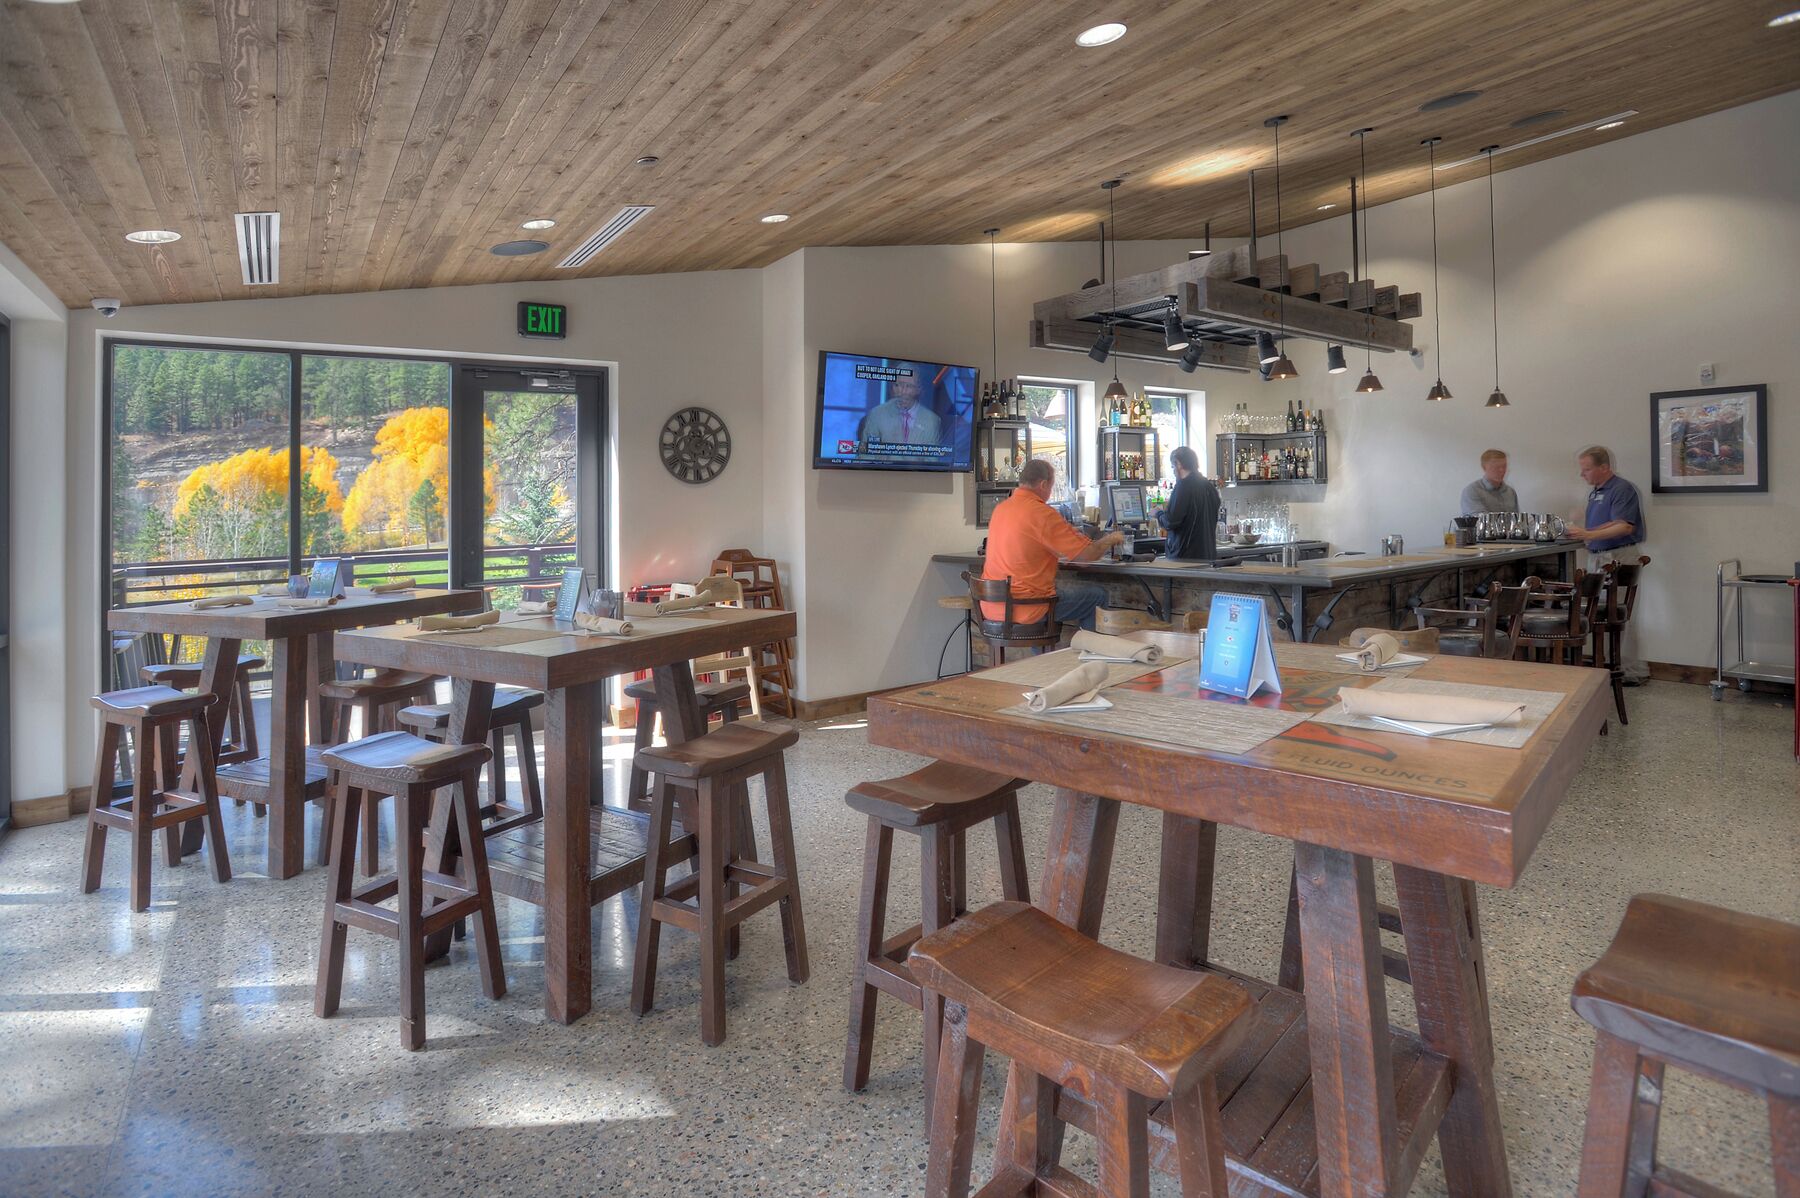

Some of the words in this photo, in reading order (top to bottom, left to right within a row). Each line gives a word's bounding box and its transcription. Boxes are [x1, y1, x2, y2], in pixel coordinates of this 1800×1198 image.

[527, 305, 561, 334] EXIT
[1288, 752, 1353, 769] FLUID
[1361, 766, 1469, 789] OUNCES
